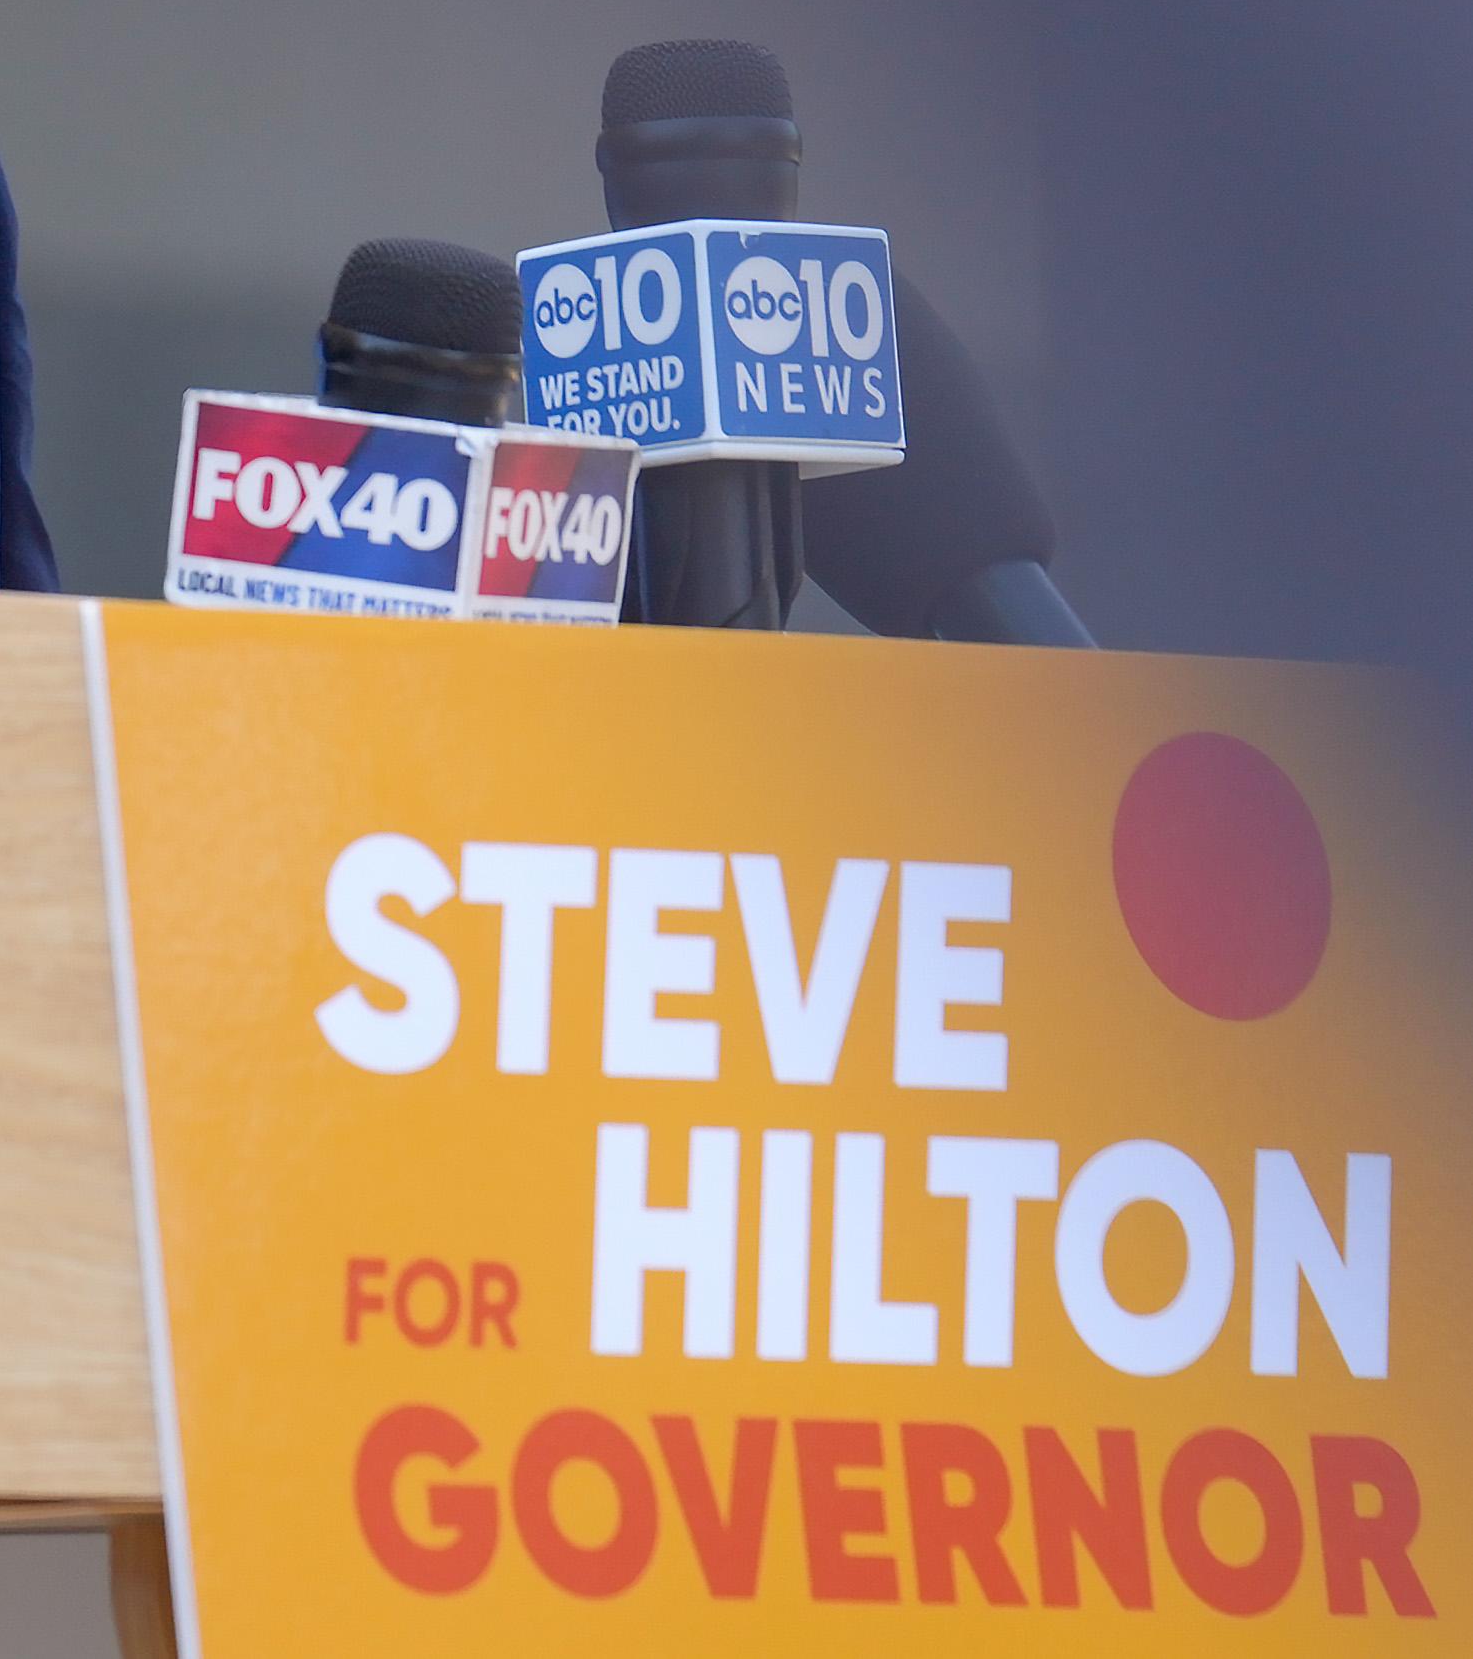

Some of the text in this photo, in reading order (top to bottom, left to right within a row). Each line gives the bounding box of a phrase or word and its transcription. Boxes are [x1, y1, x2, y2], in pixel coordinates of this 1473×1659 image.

[539, 355, 684, 410] WE STAND
[608, 396, 681, 439] YOU.
[735, 361, 886, 418] NEWS
[192, 447, 459, 551] FOX40
[485, 487, 622, 566] FOX40
[177, 567, 236, 598] LOCAL
[243, 578, 302, 607] NEWS
[307, 586, 356, 614] THAT
[313, 832, 1012, 1092] STEVE
[590, 1121, 1392, 1379] HILTON
[342, 1256, 520, 1348] FOR
[352, 1401, 1439, 1619] GOVERNOR
